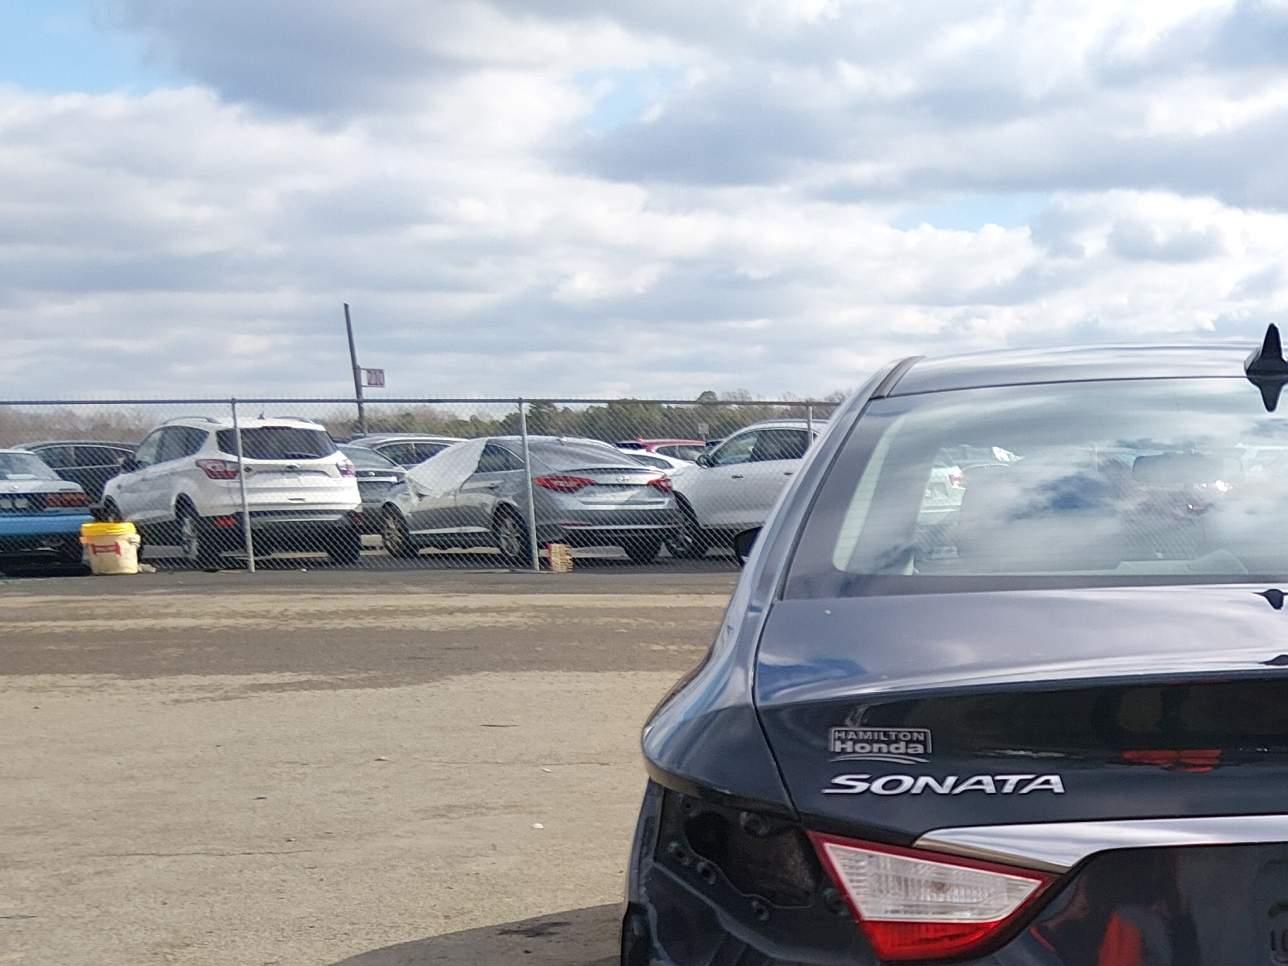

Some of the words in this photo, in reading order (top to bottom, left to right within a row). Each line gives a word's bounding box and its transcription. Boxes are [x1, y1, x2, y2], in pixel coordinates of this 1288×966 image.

[834, 731, 926, 742] HAMILTON
[834, 740, 925, 754] Honda
[822, 774, 1066, 795] SONATA
